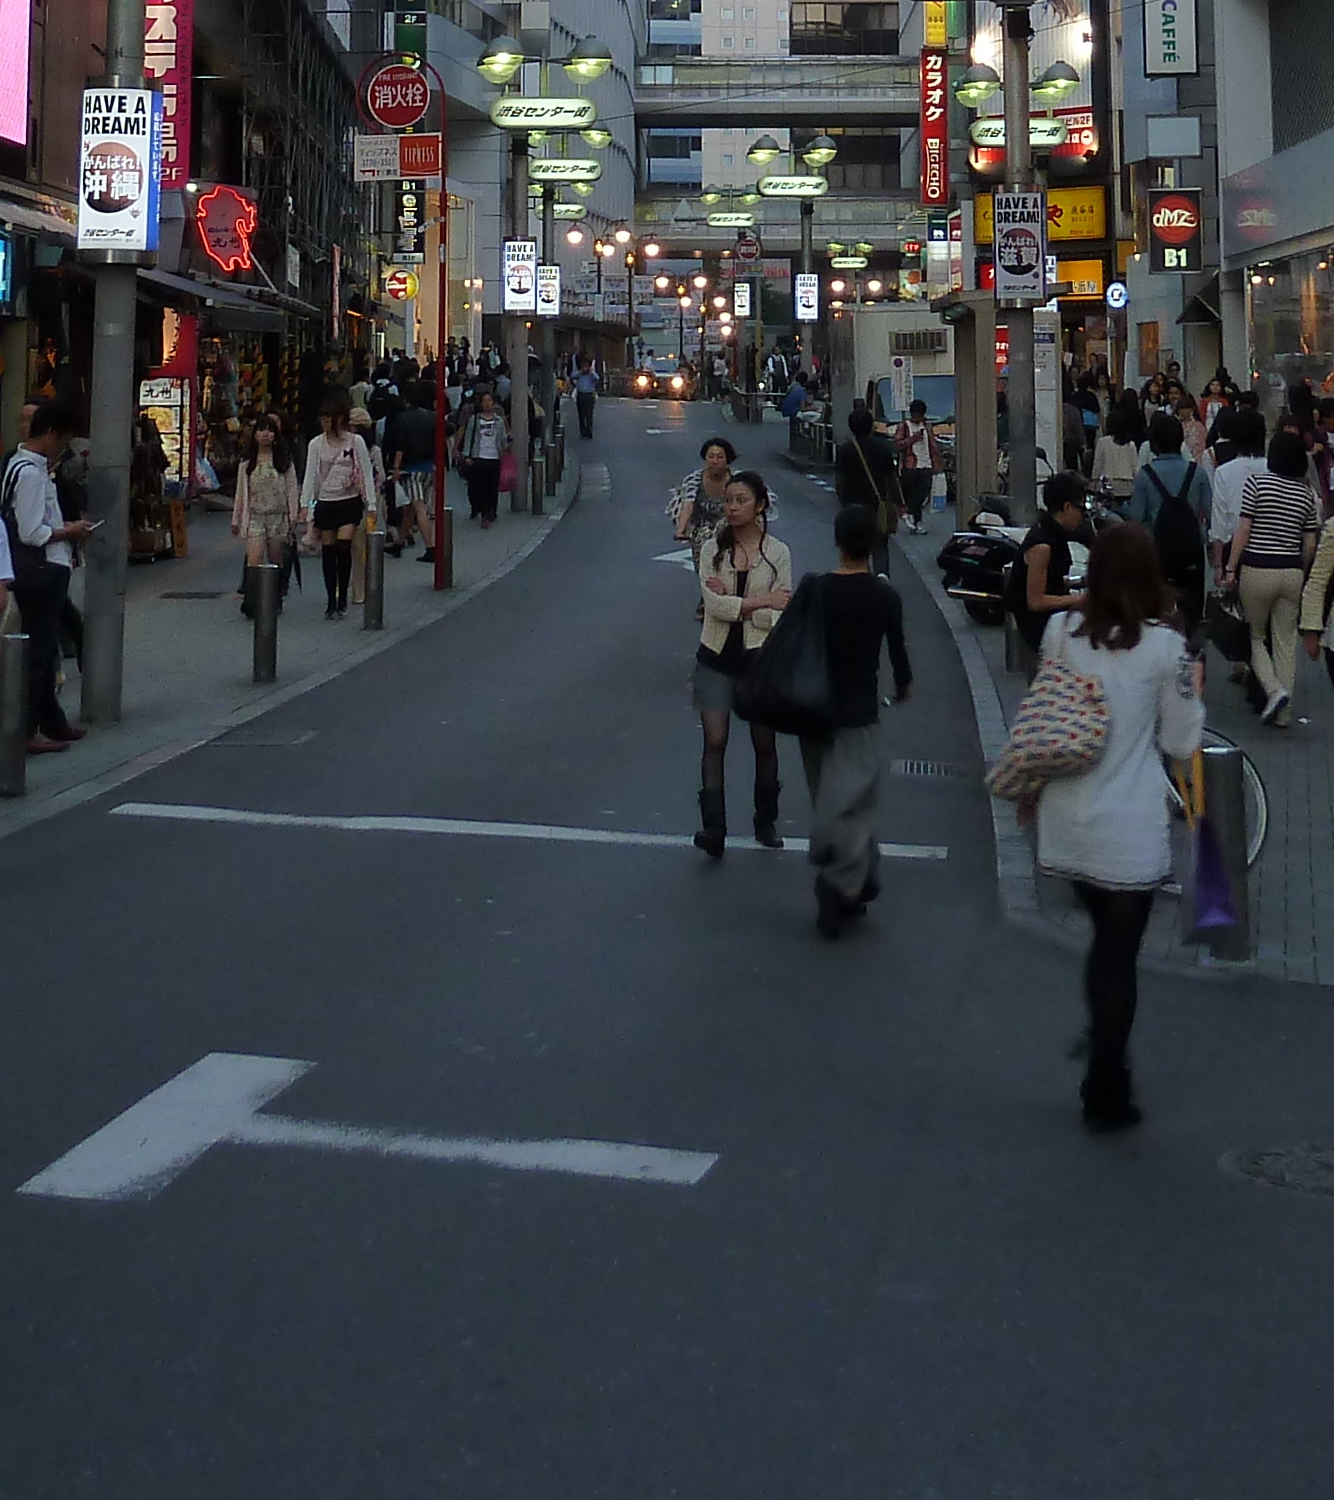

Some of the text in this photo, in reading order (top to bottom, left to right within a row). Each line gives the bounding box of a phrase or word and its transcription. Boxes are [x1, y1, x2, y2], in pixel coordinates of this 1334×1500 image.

[405, 13, 417, 23] 2F
[373, 83, 425, 110] 消火栓
[925, 55, 944, 122] カラオケ
[85, 95, 146, 114] HAVE A
[496, 106, 591, 119] 渋谷センター街
[85, 116, 146, 136] DREAM!
[85, 174, 141, 201] 沖縄
[997, 197, 1040, 210] HAVE A
[997, 211, 1040, 224] DREAM!
[1164, 248, 1189, 267] B1
